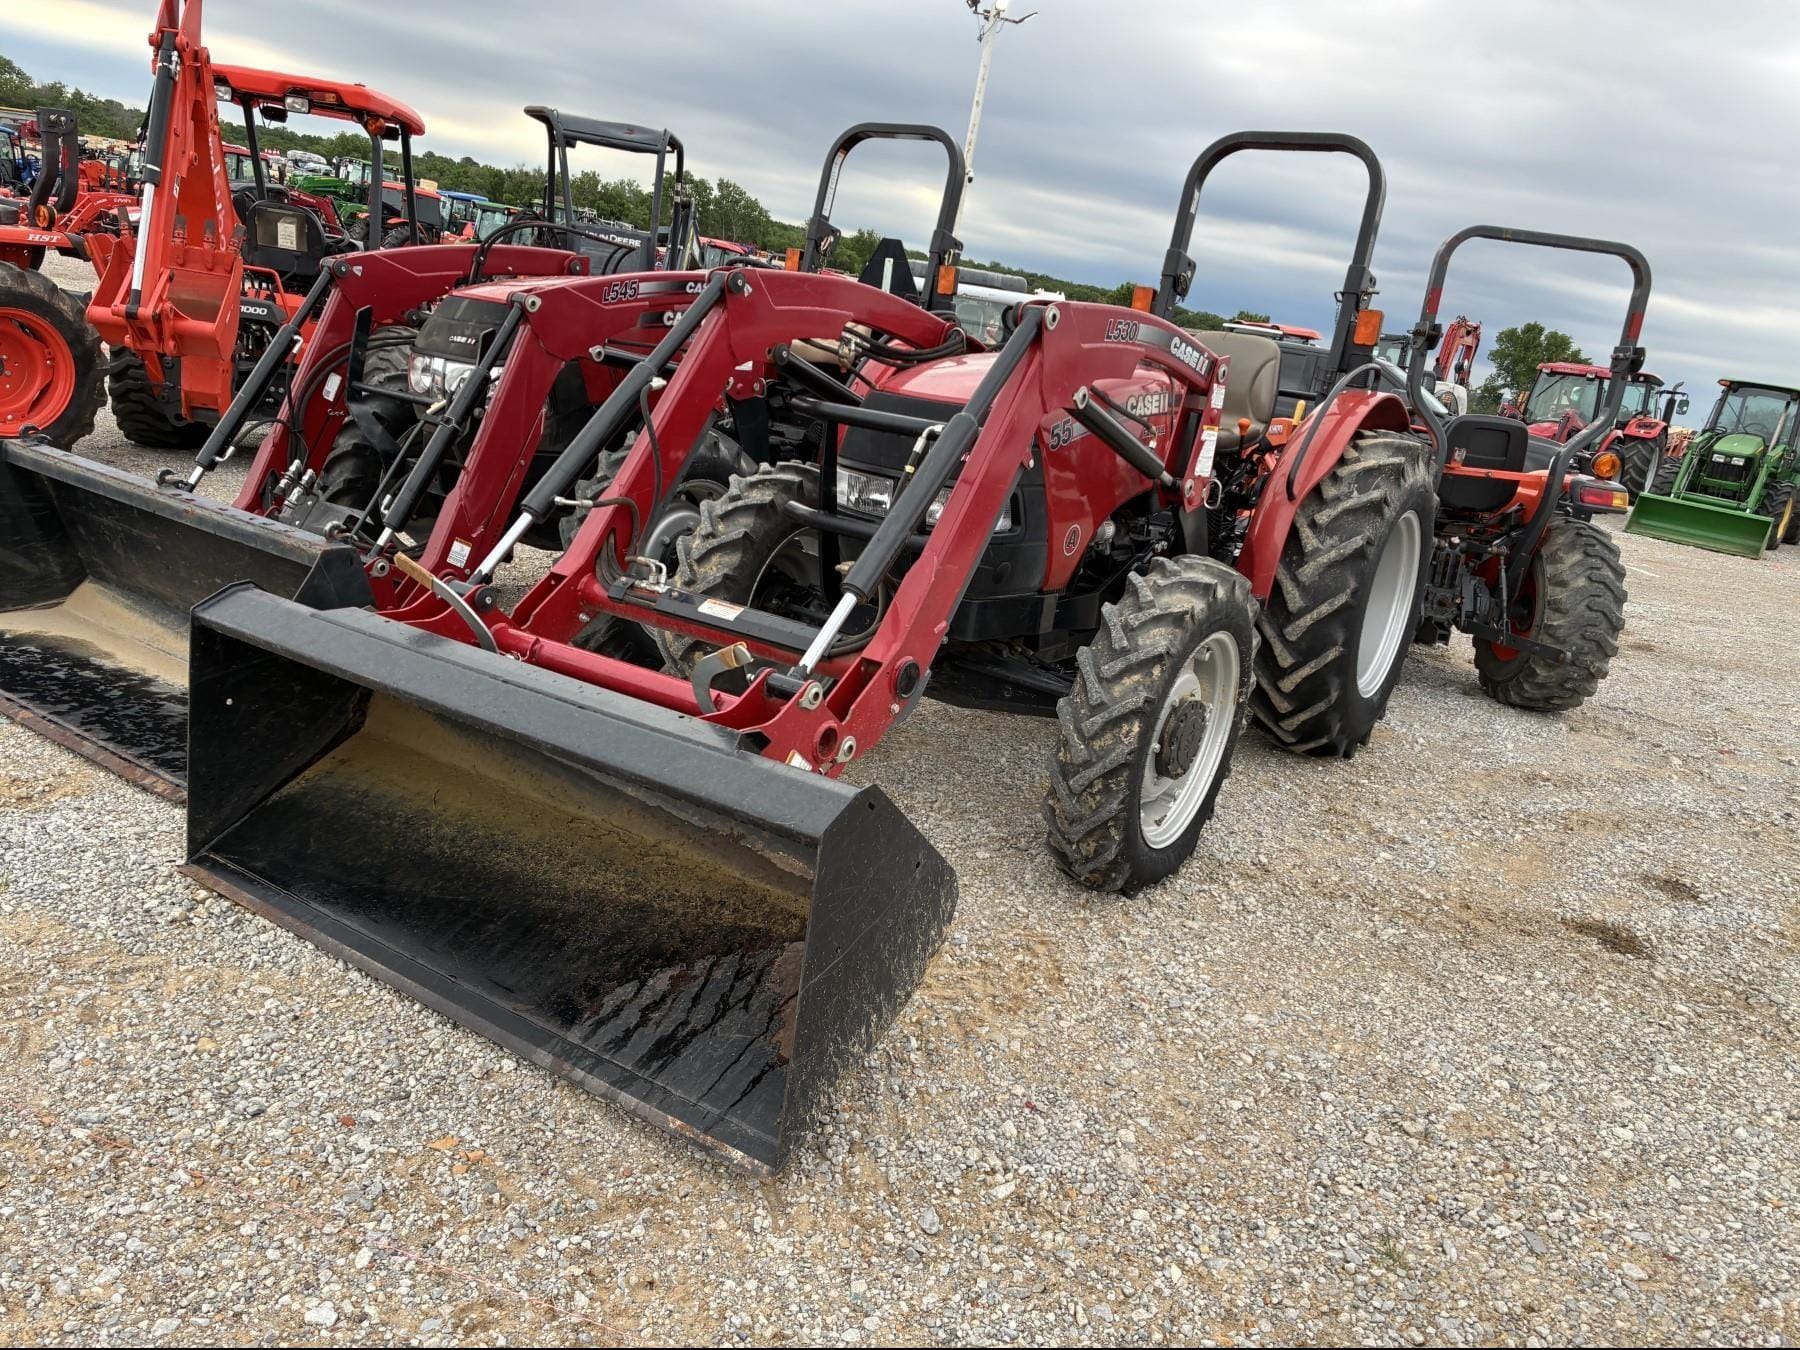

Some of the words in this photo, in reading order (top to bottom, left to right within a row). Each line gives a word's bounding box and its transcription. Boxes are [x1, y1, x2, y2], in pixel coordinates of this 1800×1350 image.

[27, 233, 61, 243] HST
[610, 234, 641, 248] DEERE
[602, 280, 639, 304] L545
[686, 282, 711, 294] CAS
[663, 311, 684, 326] CA
[1104, 319, 1139, 343] L530
